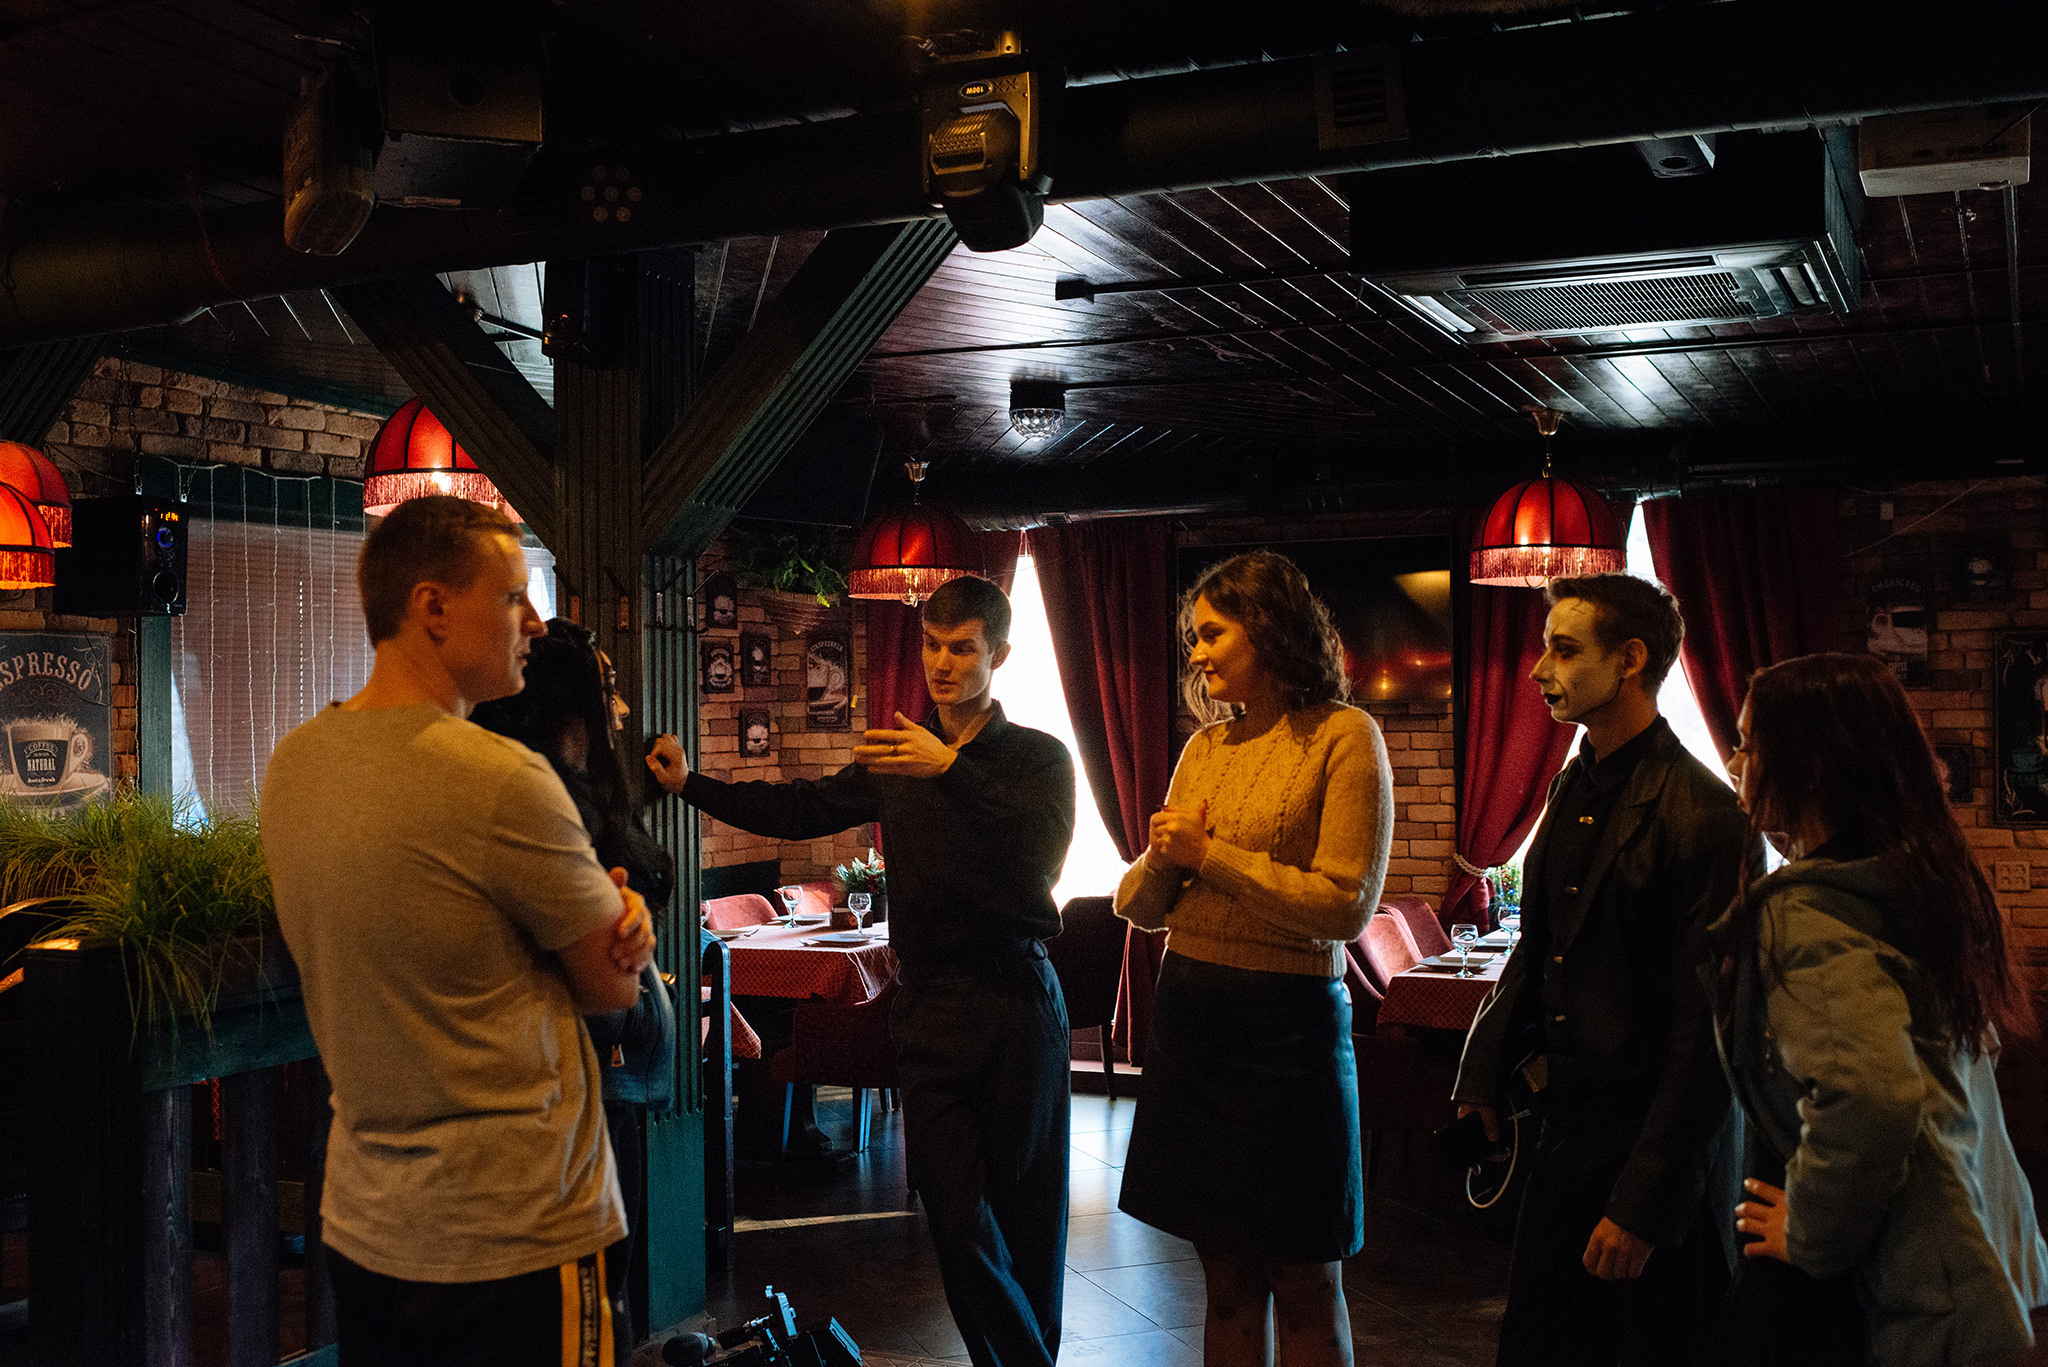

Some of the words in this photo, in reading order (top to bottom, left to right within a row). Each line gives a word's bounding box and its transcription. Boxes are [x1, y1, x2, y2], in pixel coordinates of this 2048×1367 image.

[966, 85, 984, 95] 100W
[0, 651, 92, 691] SPRESSO
[27, 758, 56, 772] NATURAL
